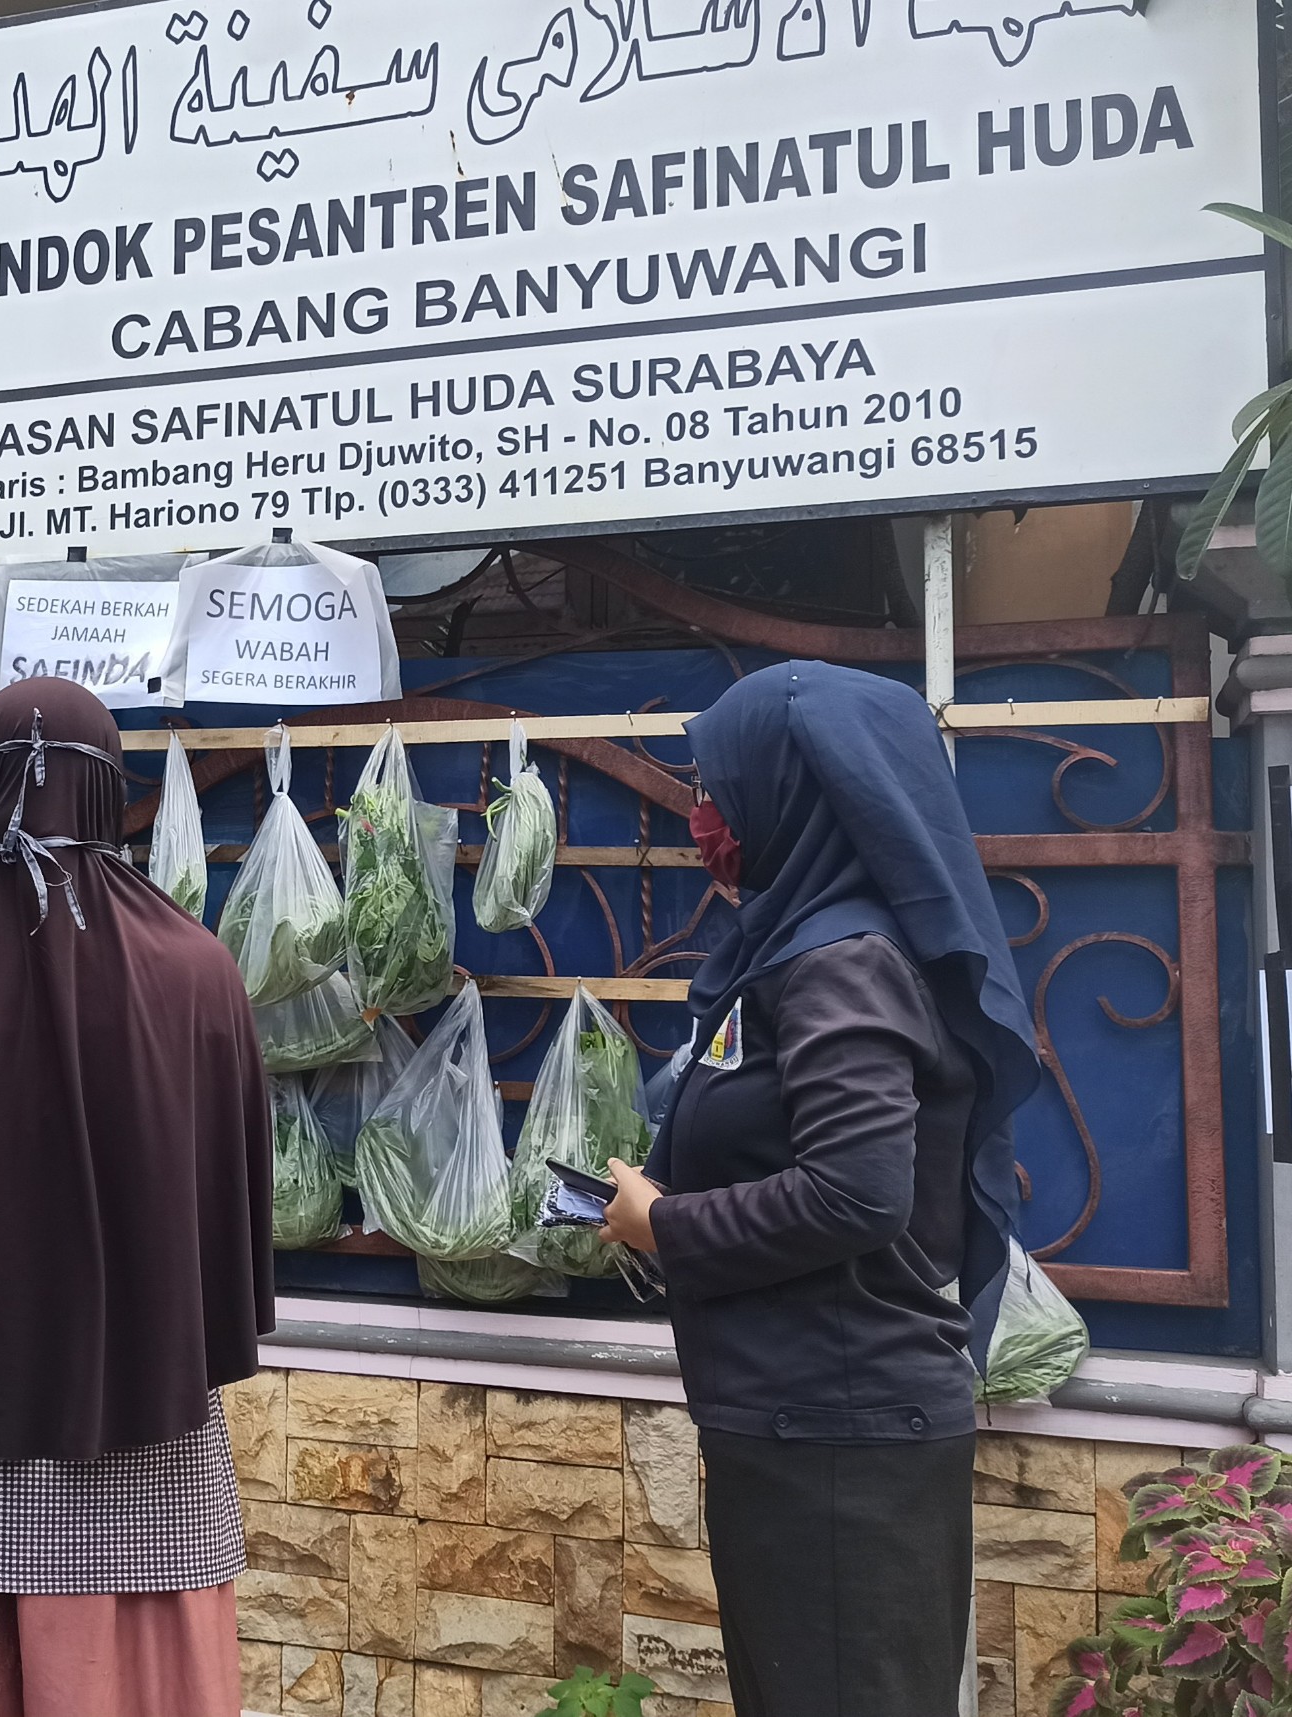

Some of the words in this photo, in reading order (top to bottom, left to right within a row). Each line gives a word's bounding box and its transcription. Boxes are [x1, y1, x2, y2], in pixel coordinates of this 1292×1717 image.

[166, 0, 440, 182] سفينة
[174, 171, 535, 274] PESANTREN
[560, 120, 950, 225] SAFINATUL
[978, 85, 1194, 175] HUDA
[112, 288, 388, 359] CABANG
[416, 223, 925, 328] BANYUWANGI
[132, 388, 392, 446] SAFINATUL
[411, 370, 554, 419] HUDA
[572, 339, 876, 402] SURABAYA
[59, 475, 64, 494] :
[79, 460, 232, 504] Bambang
[247, 451, 324, 479] Heru
[340, 434, 482, 476] Djuwito,
[497, 424, 548, 455] SH
[590, 418, 650, 448] No.
[666, 410, 709, 441] 08
[724, 403, 847, 436] Tahun
[864, 387, 961, 424] 2010
[0, 512, 33, 538] Jl.
[47, 506, 96, 535] MT.
[110, 499, 239, 530] Hariono
[252, 491, 289, 519] 79
[302, 486, 364, 520] Tlp.
[379, 473, 486, 517] (0333)
[499, 461, 624, 498] 411251
[644, 438, 894, 490] Banyuwangi
[911, 427, 1037, 466] 68515
[17, 597, 95, 615] SEDEKAH
[101, 601, 169, 617] BERKAH
[51, 626, 125, 643] JAMAAH
[207, 589, 357, 621] SEMOGA
[10, 652, 151, 687] SAFINDA
[201, 670, 267, 687] SEGERA
[274, 675, 356, 689] BERAKHIR
[236, 640, 329, 661] WABAH
